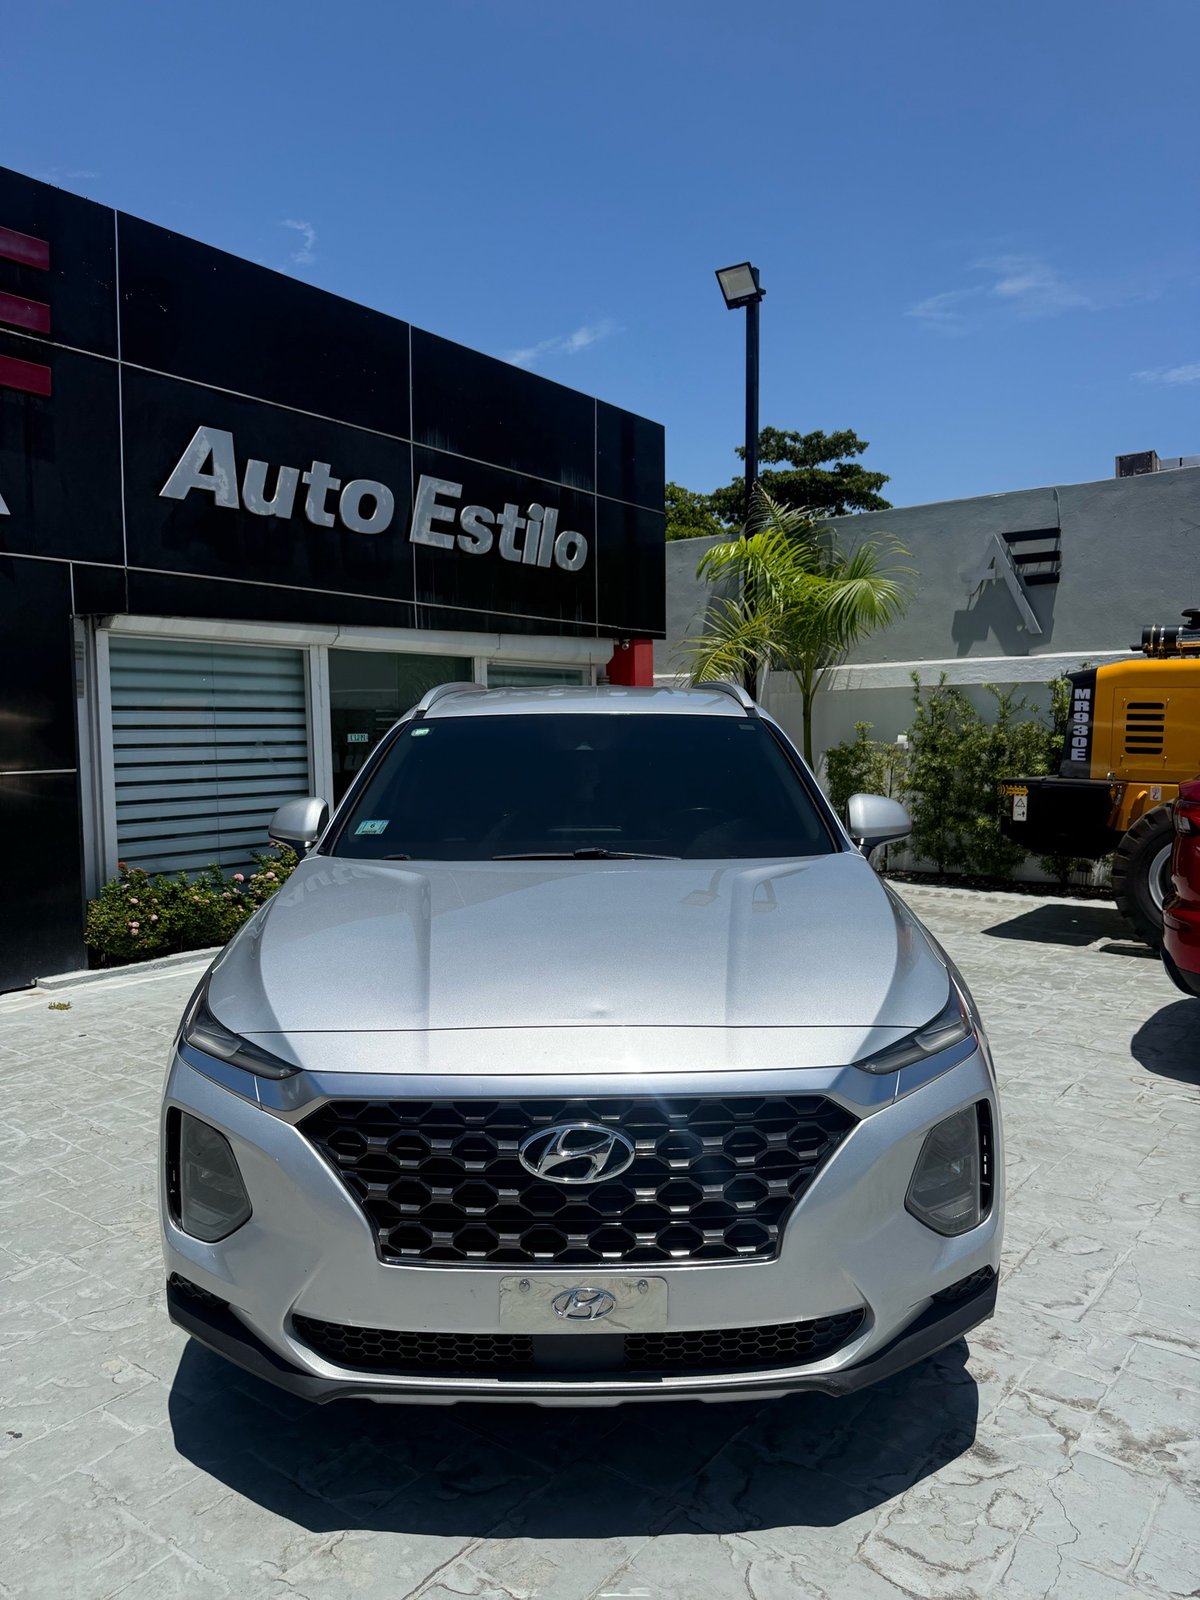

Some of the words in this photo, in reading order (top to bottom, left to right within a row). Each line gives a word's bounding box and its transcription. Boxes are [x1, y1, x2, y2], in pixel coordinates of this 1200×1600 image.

[159, 425, 395, 535] Auto
[409, 474, 588, 572] Estilo
[1071, 688, 1091, 762] MR930E
